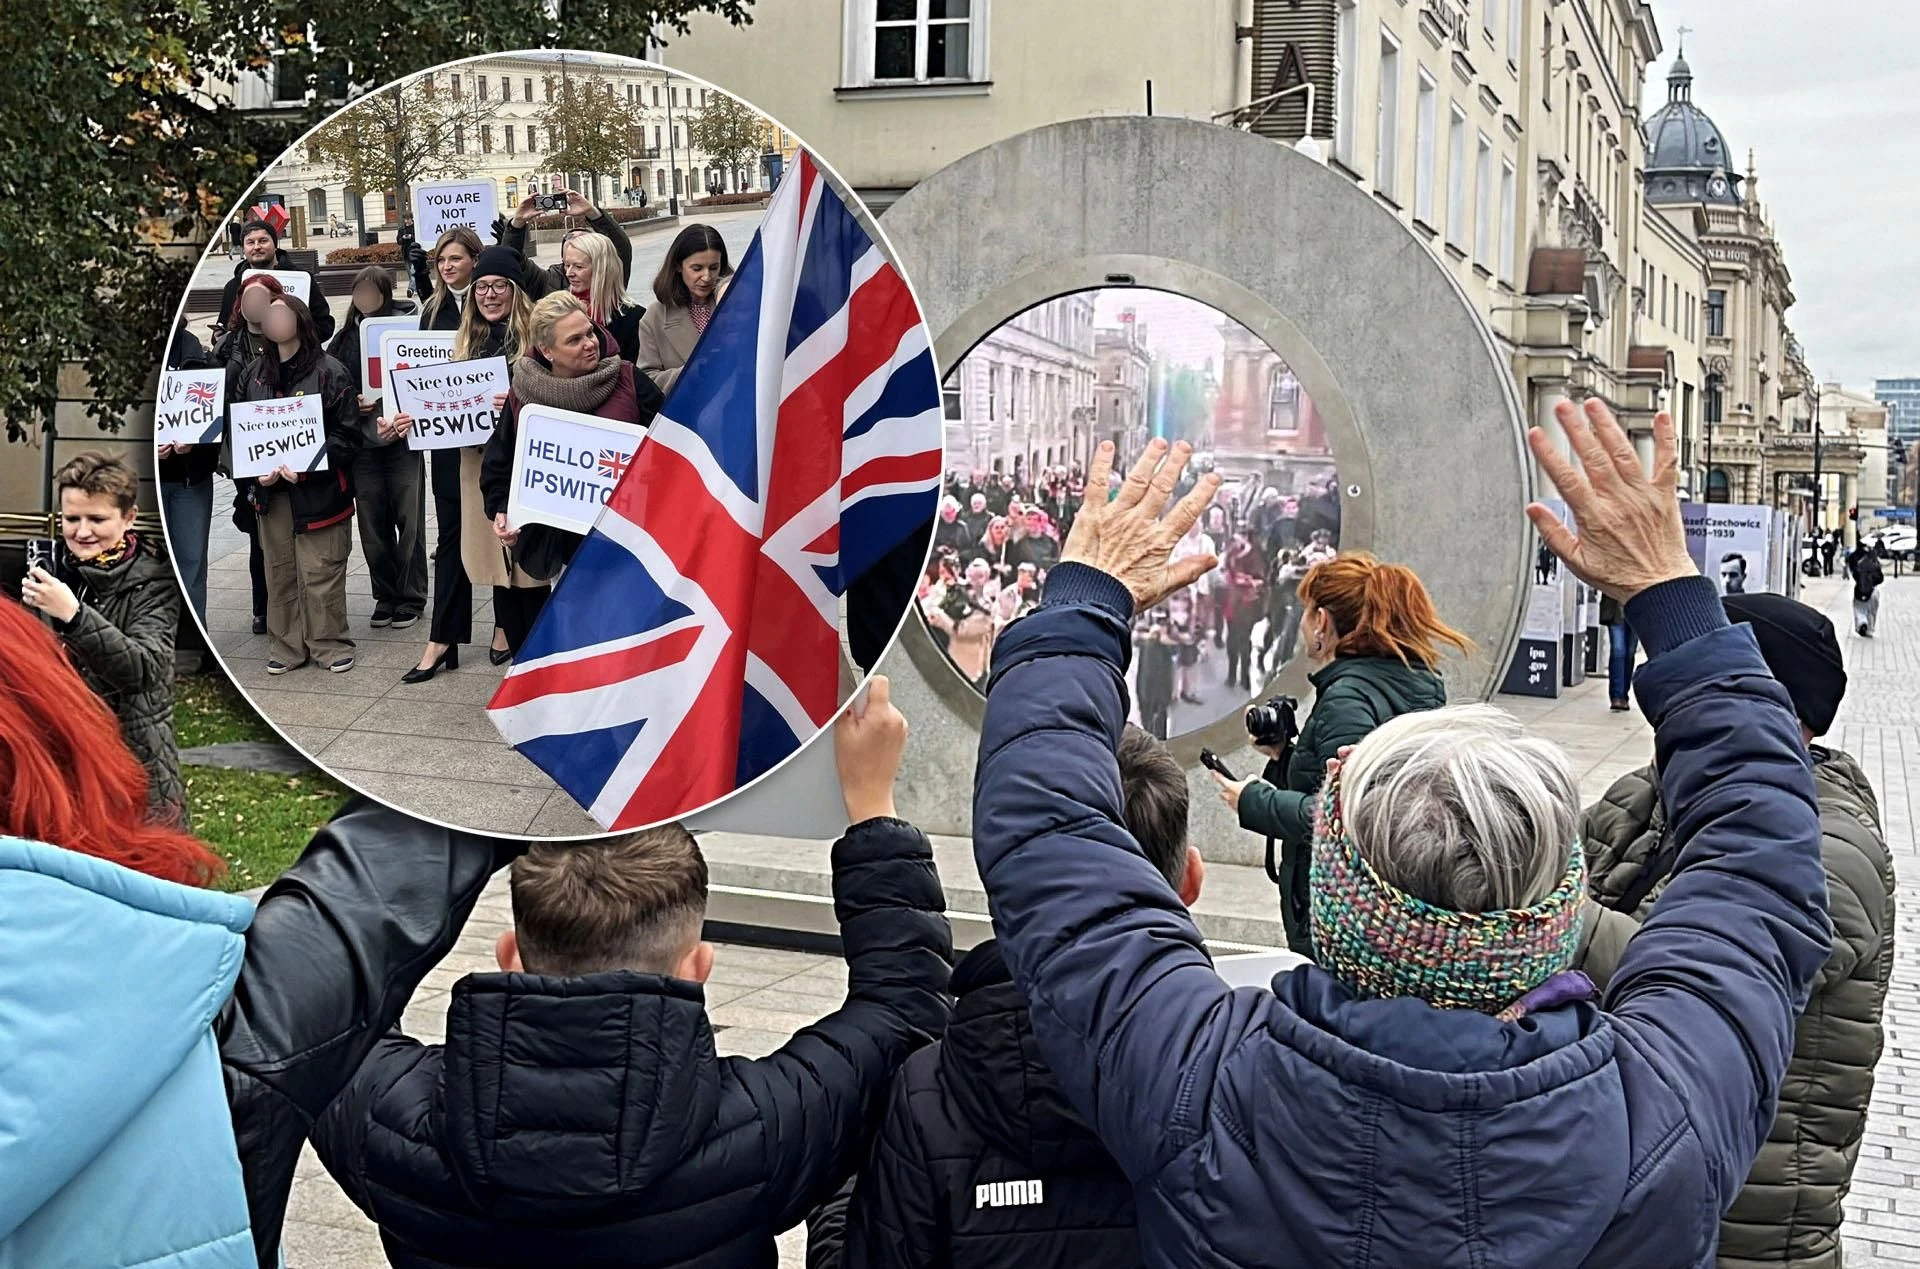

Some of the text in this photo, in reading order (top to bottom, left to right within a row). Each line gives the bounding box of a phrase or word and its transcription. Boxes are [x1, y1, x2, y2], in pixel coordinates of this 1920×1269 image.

[426, 192, 481, 206] YOU ARE
[441, 208, 467, 219] NOT
[407, 371, 494, 392] Nice to see
[440, 389, 463, 398] YOU
[237, 415, 318, 433] Nice to see you
[247, 428, 317, 462] IPSWICH
[528, 438, 595, 469] HELLO
[975, 1179, 1044, 1209] PUMA
